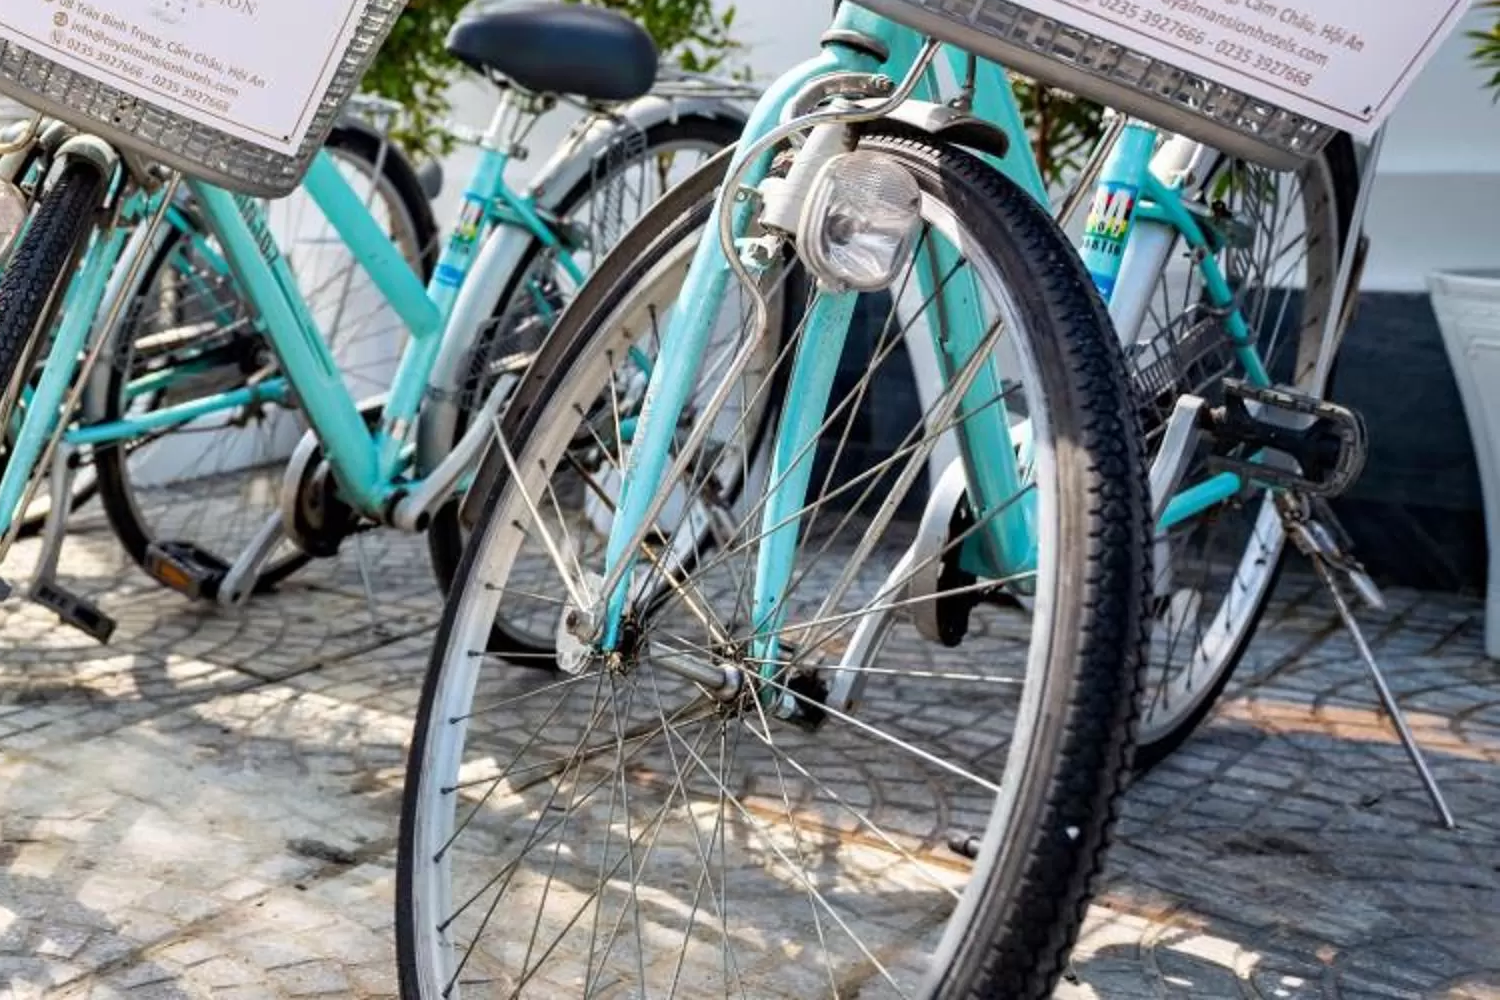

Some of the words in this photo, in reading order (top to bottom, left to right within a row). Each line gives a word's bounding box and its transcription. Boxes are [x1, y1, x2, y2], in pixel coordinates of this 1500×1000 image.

[1140, 10, 1206, 44] 3927666
[1215, 40, 1252, 64] 0235
[1345, 34, 1365, 52] An
